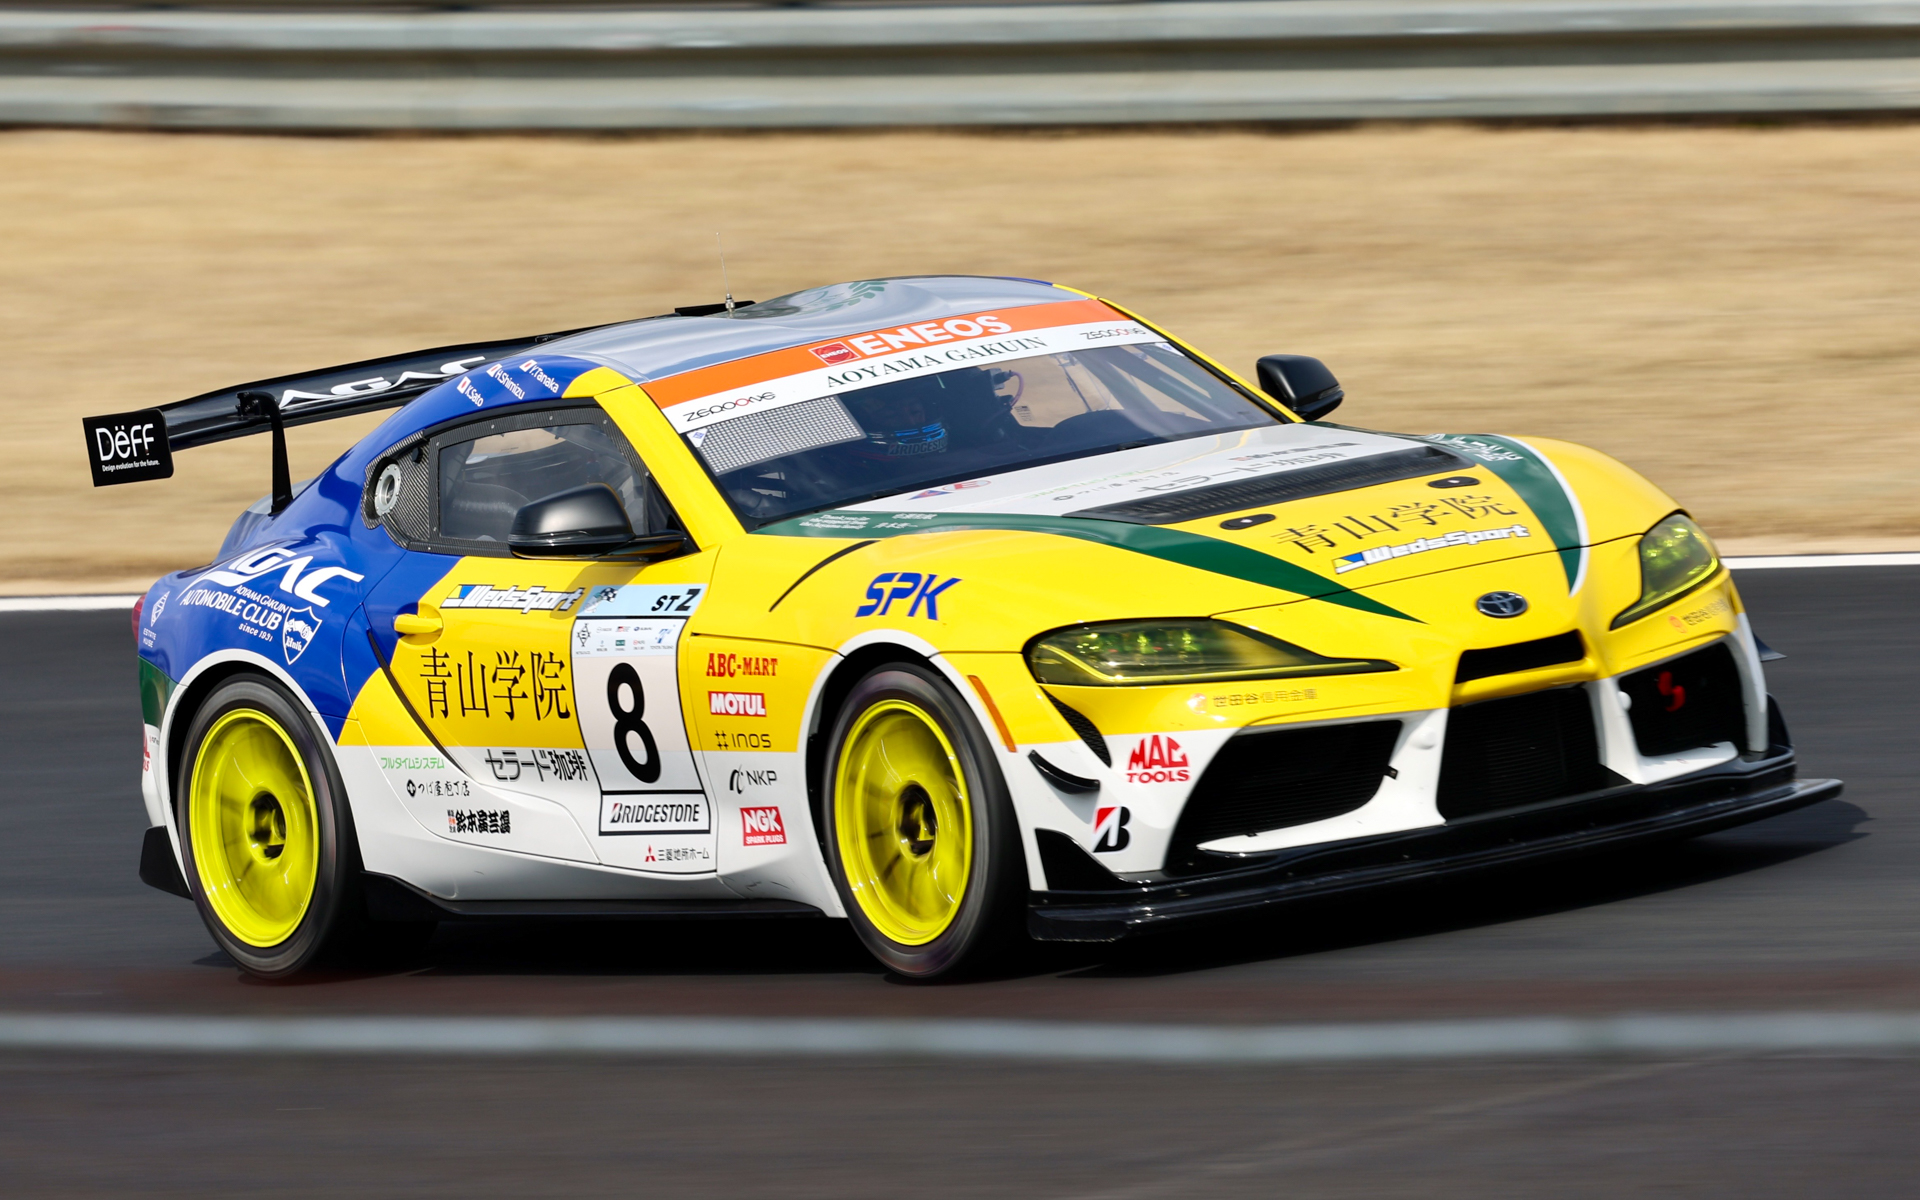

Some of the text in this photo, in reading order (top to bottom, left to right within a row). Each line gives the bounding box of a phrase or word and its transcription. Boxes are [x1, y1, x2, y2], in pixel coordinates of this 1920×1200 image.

[848, 315, 1011, 356] ENEOS
[828, 337, 1048, 388] AOYAMA GAKUIN
[528, 365, 560, 394] Y.Tanaka
[102, 464, 115, 472] Design
[116, 462, 133, 470] evolution
[1270, 494, 1518, 555] 青山学院
[1362, 524, 1530, 565] WedsSport
[180, 589, 282, 631] AUTOMOBILE CLUB
[233, 585, 289, 613] AOYAMA GAKUIN
[465, 584, 585, 614] WedsSport
[855, 572, 963, 621] SPK
[239, 623, 273, 642] since 1931
[706, 652, 778, 678] ABC-MART
[419, 646, 571, 722] 青山学院
[710, 692, 766, 716] MOTUL
[607, 662, 662, 784] 8
[380, 757, 445, 769] フルタイムシステム
[484, 748, 588, 782] セラード珈琲
[1128, 734, 1190, 770] MAC
[747, 770, 777, 786] NKP
[1126, 769, 1190, 784] TOOLS
[609, 802, 700, 824] BRIDGESTONE
[743, 809, 781, 833] NGK
[746, 833, 784, 845] SPARK PLUGS
[1093, 805, 1131, 853] B
[658, 847, 710, 861] 三菱地所ホーム
